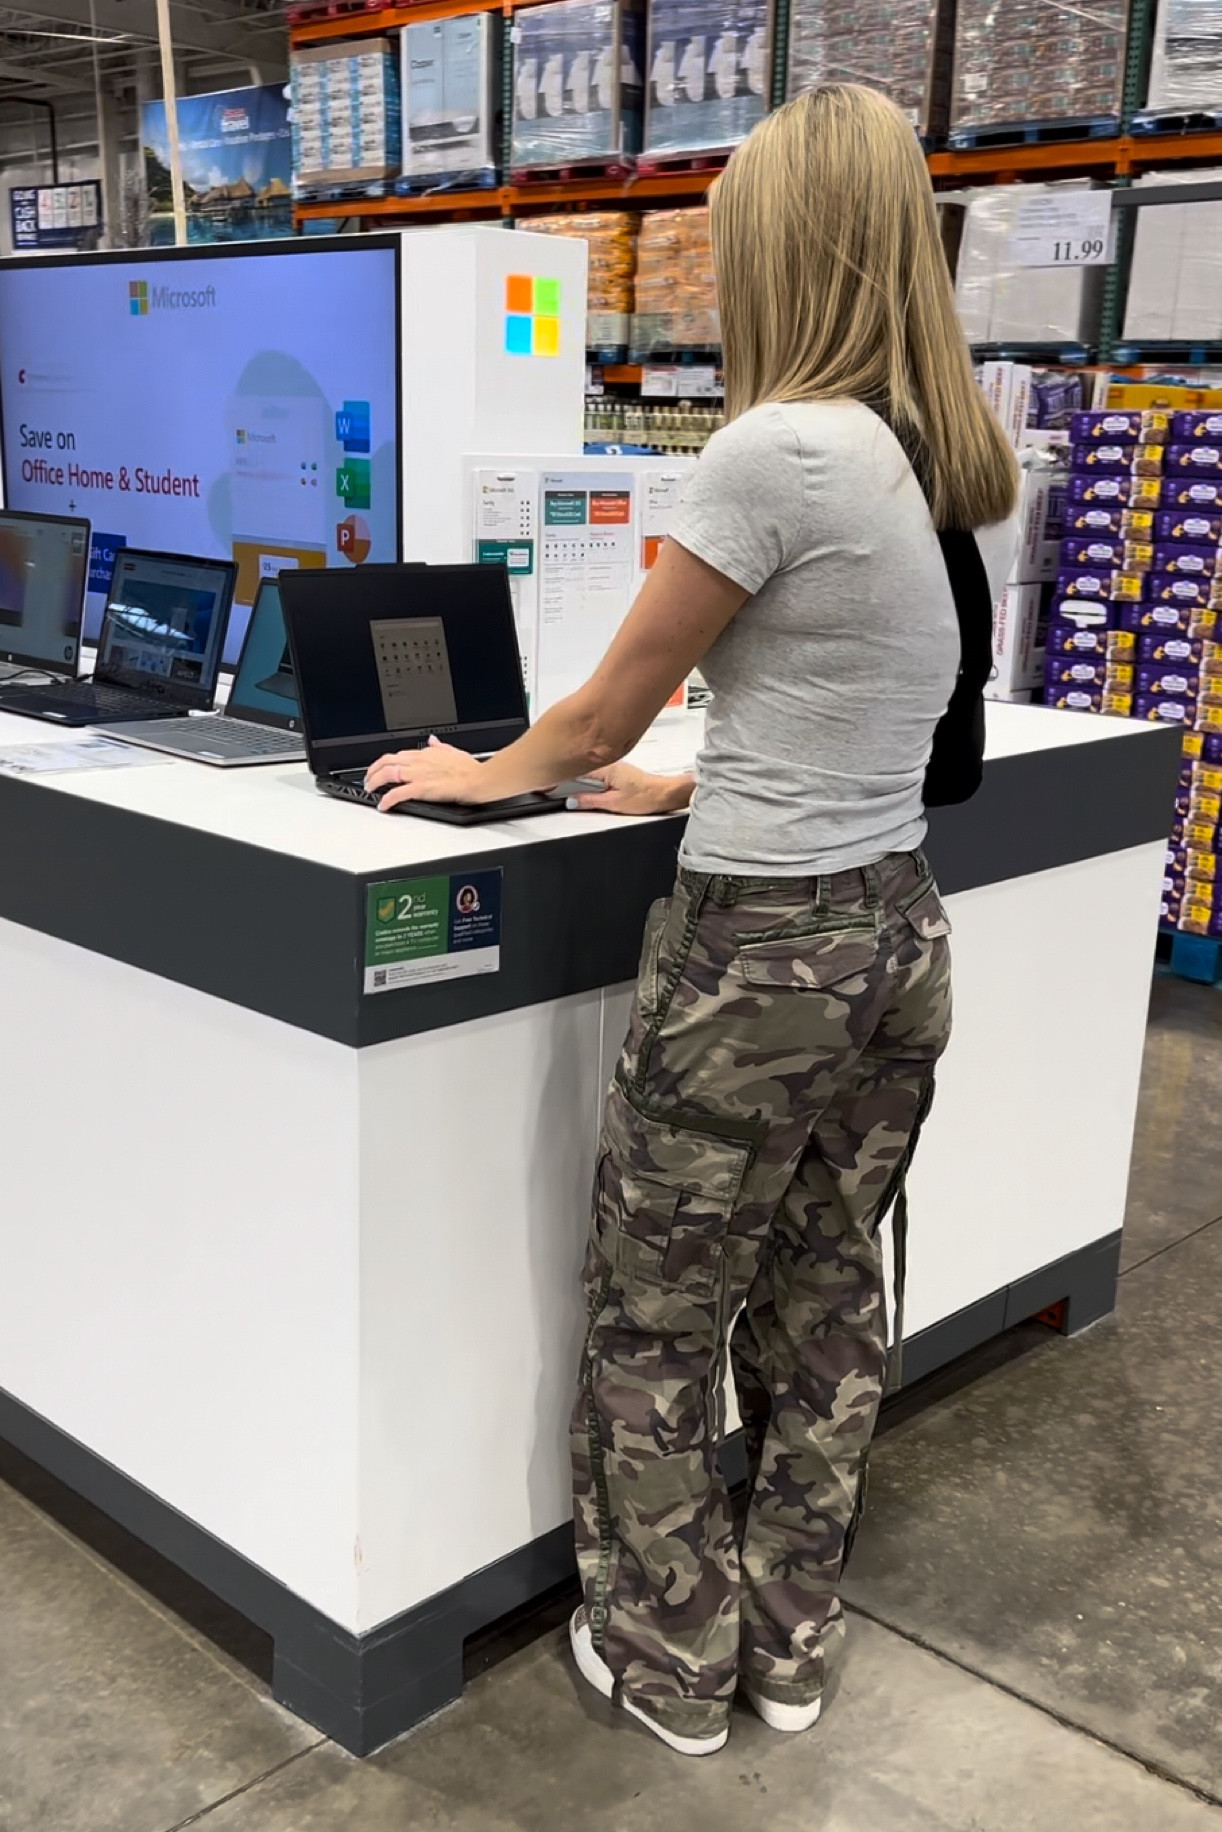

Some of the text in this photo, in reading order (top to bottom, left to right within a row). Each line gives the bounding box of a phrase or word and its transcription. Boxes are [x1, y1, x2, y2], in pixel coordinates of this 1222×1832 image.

[1052, 239, 1103, 261] 11.99
[151, 284, 216, 309] Microsoft
[19, 424, 76, 450] Save on
[336, 418, 351, 434] W
[21, 460, 200, 498] Office Home & Student
[340, 474, 349, 491] X
[340, 529, 350, 546] P
